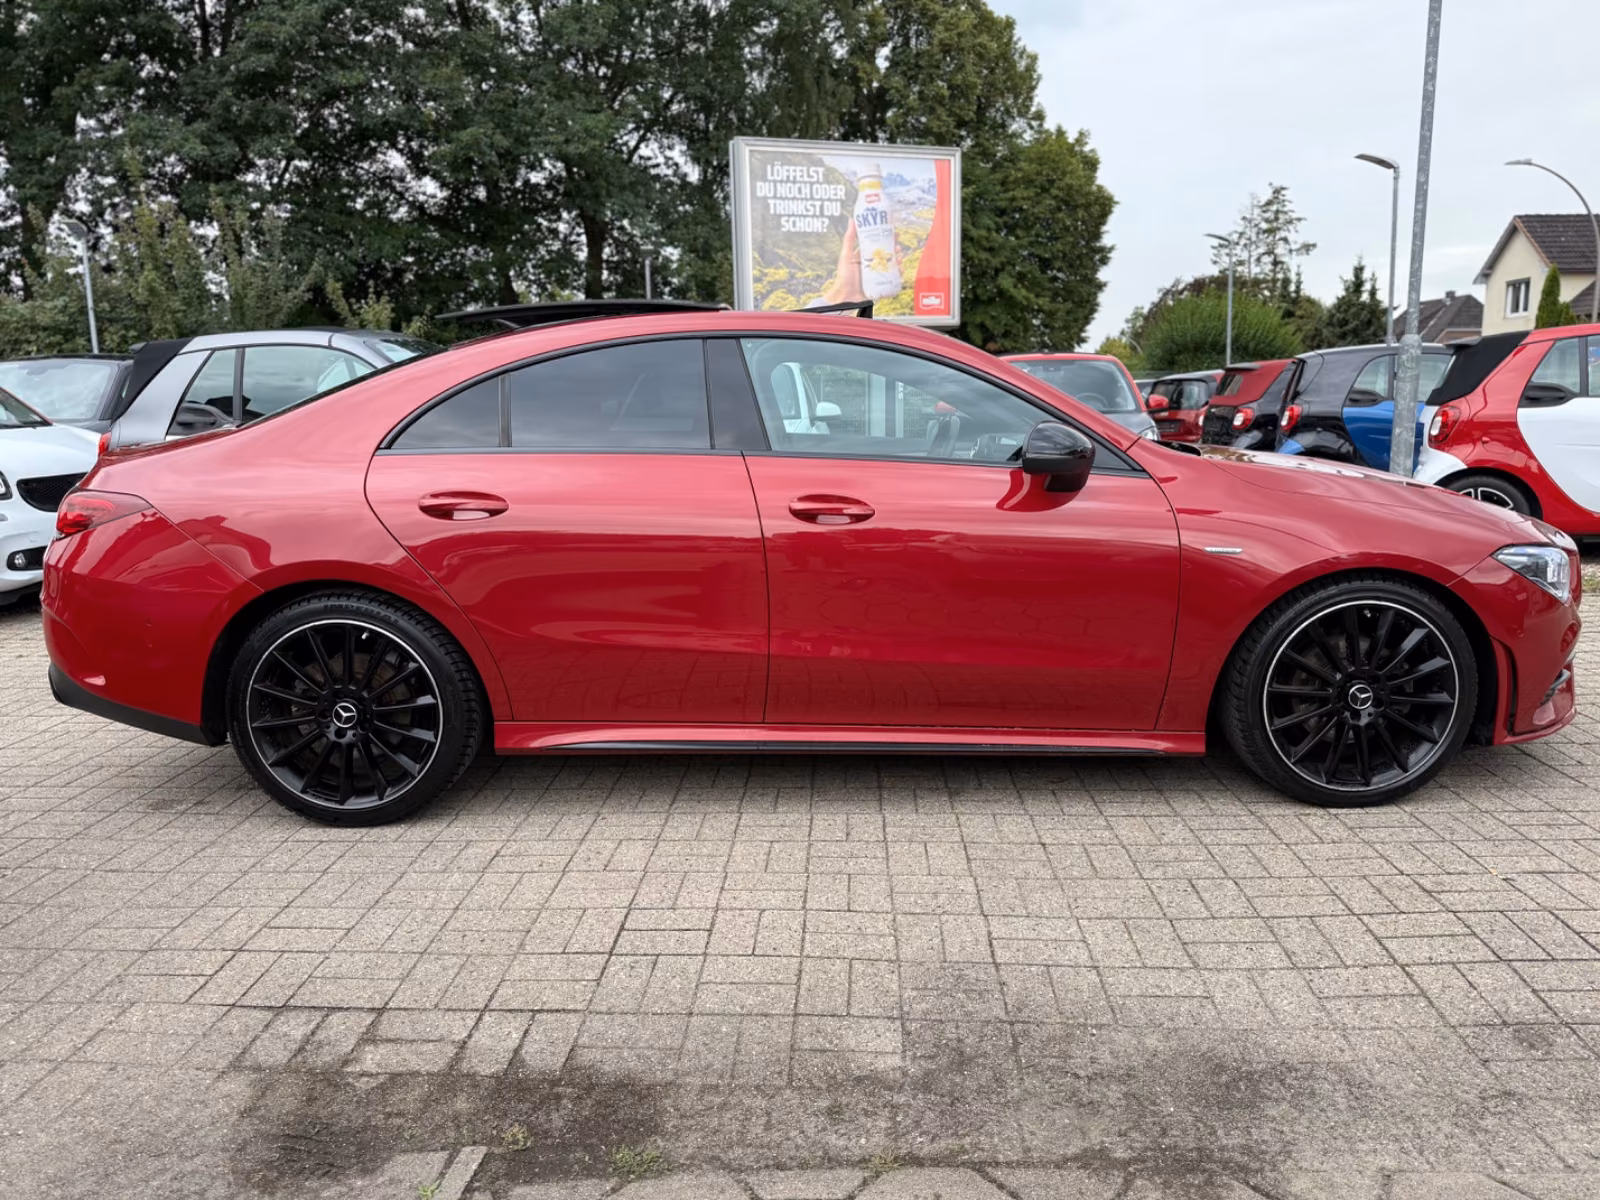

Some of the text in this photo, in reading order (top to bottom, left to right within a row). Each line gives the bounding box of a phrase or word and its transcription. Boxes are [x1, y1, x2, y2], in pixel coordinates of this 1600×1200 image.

[767, 161, 825, 182] LÖFFELST
[756, 181, 775, 198] DU
[776, 182, 811, 199] NOCH
[812, 184, 846, 200] ODER
[768, 199, 841, 217] TRINKST DU
[780, 216, 830, 233] SCHON?
[855, 210, 888, 229] SKYR
